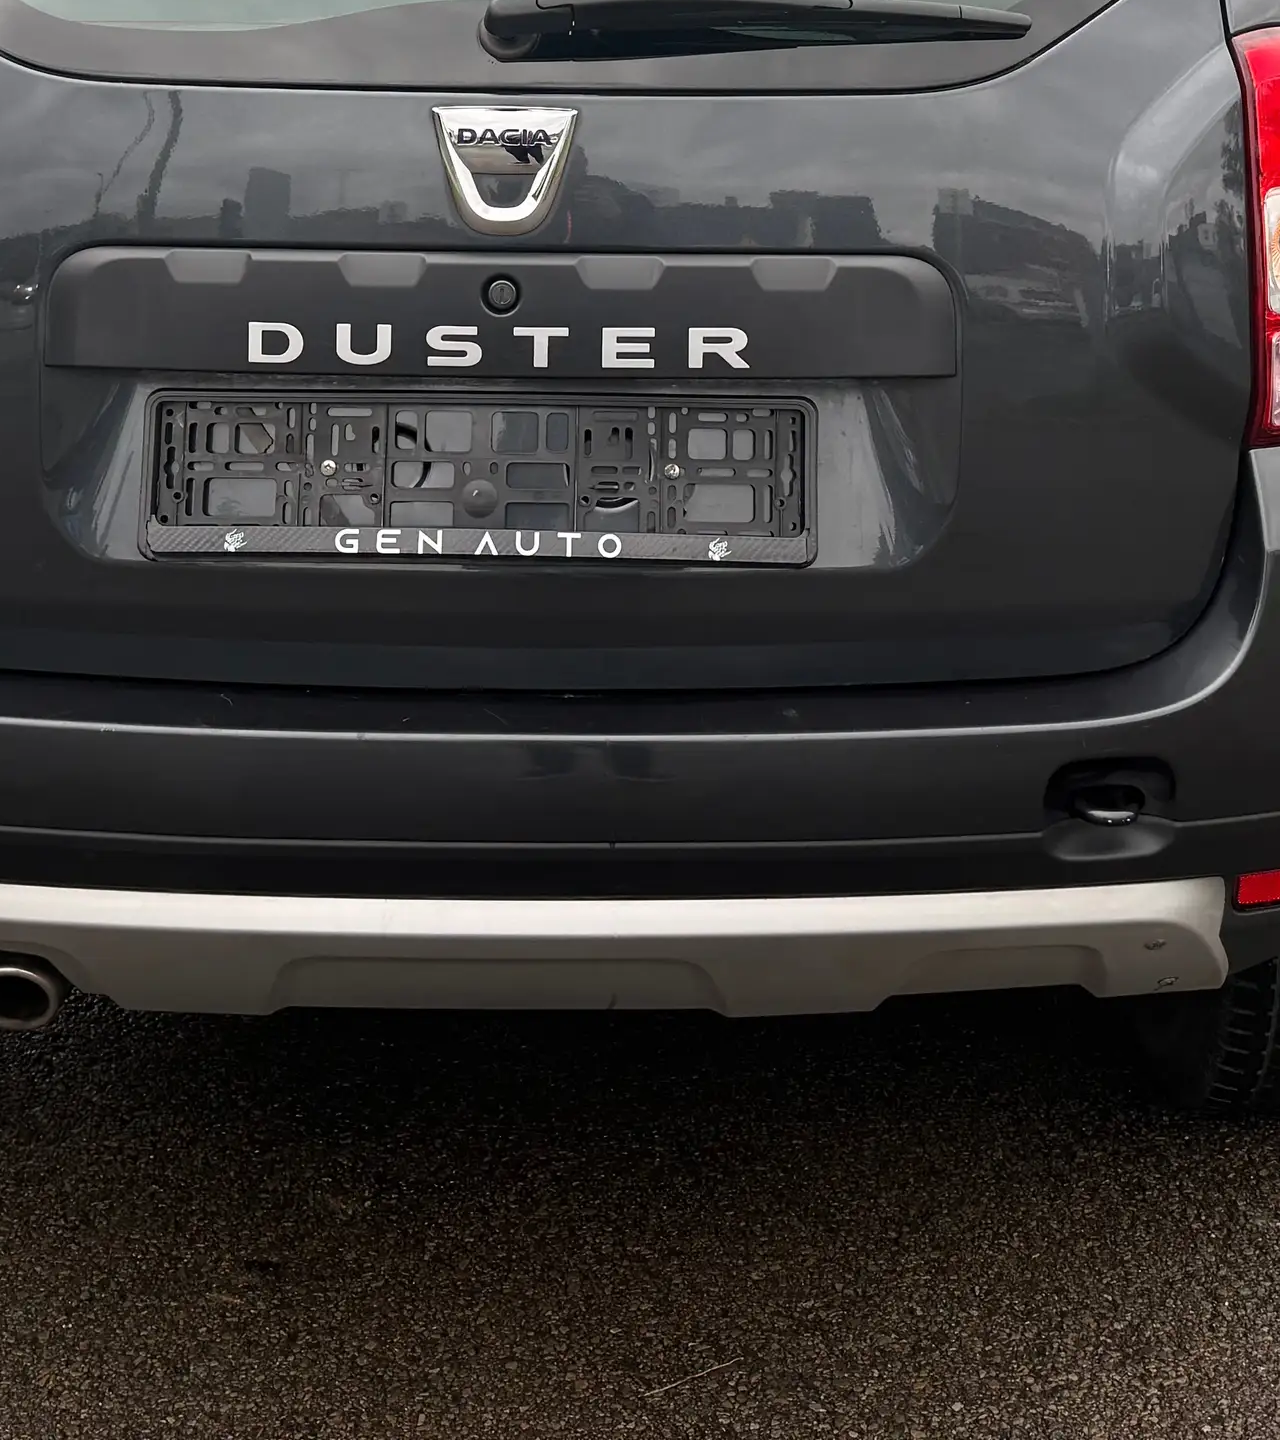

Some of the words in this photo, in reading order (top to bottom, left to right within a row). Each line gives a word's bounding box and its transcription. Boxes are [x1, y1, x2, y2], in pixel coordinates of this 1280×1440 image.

[457, 127, 554, 147] DACIA
[247, 321, 751, 370] DUSTER
[334, 528, 444, 555] GEN
[474, 531, 623, 559] AUTO
